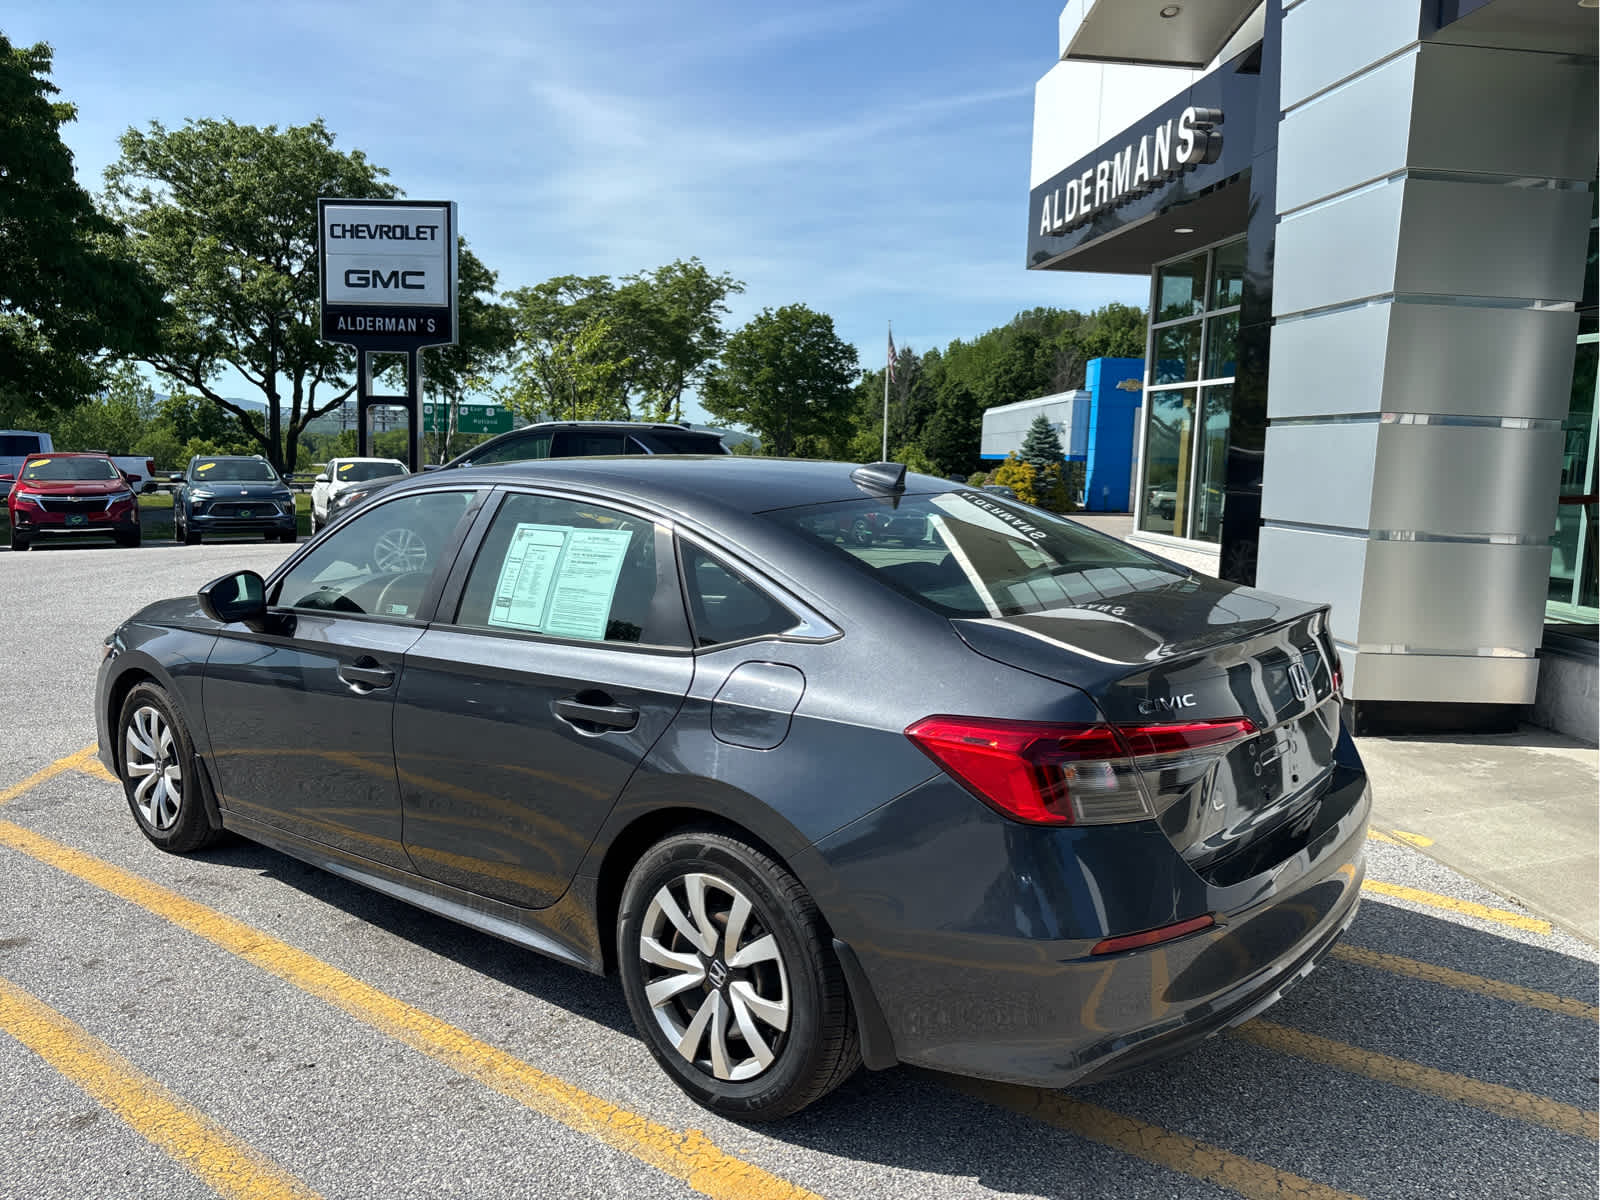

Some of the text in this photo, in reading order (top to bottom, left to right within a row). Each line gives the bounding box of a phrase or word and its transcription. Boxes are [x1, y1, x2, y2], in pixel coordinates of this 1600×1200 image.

[1040, 106, 1196, 236] ALDERMANS
[330, 223, 439, 241] CHEVROLET
[344, 269, 425, 290] GMC
[337, 316, 436, 333] ALDERMAN'S
[1138, 693, 1197, 714] CIVIC
